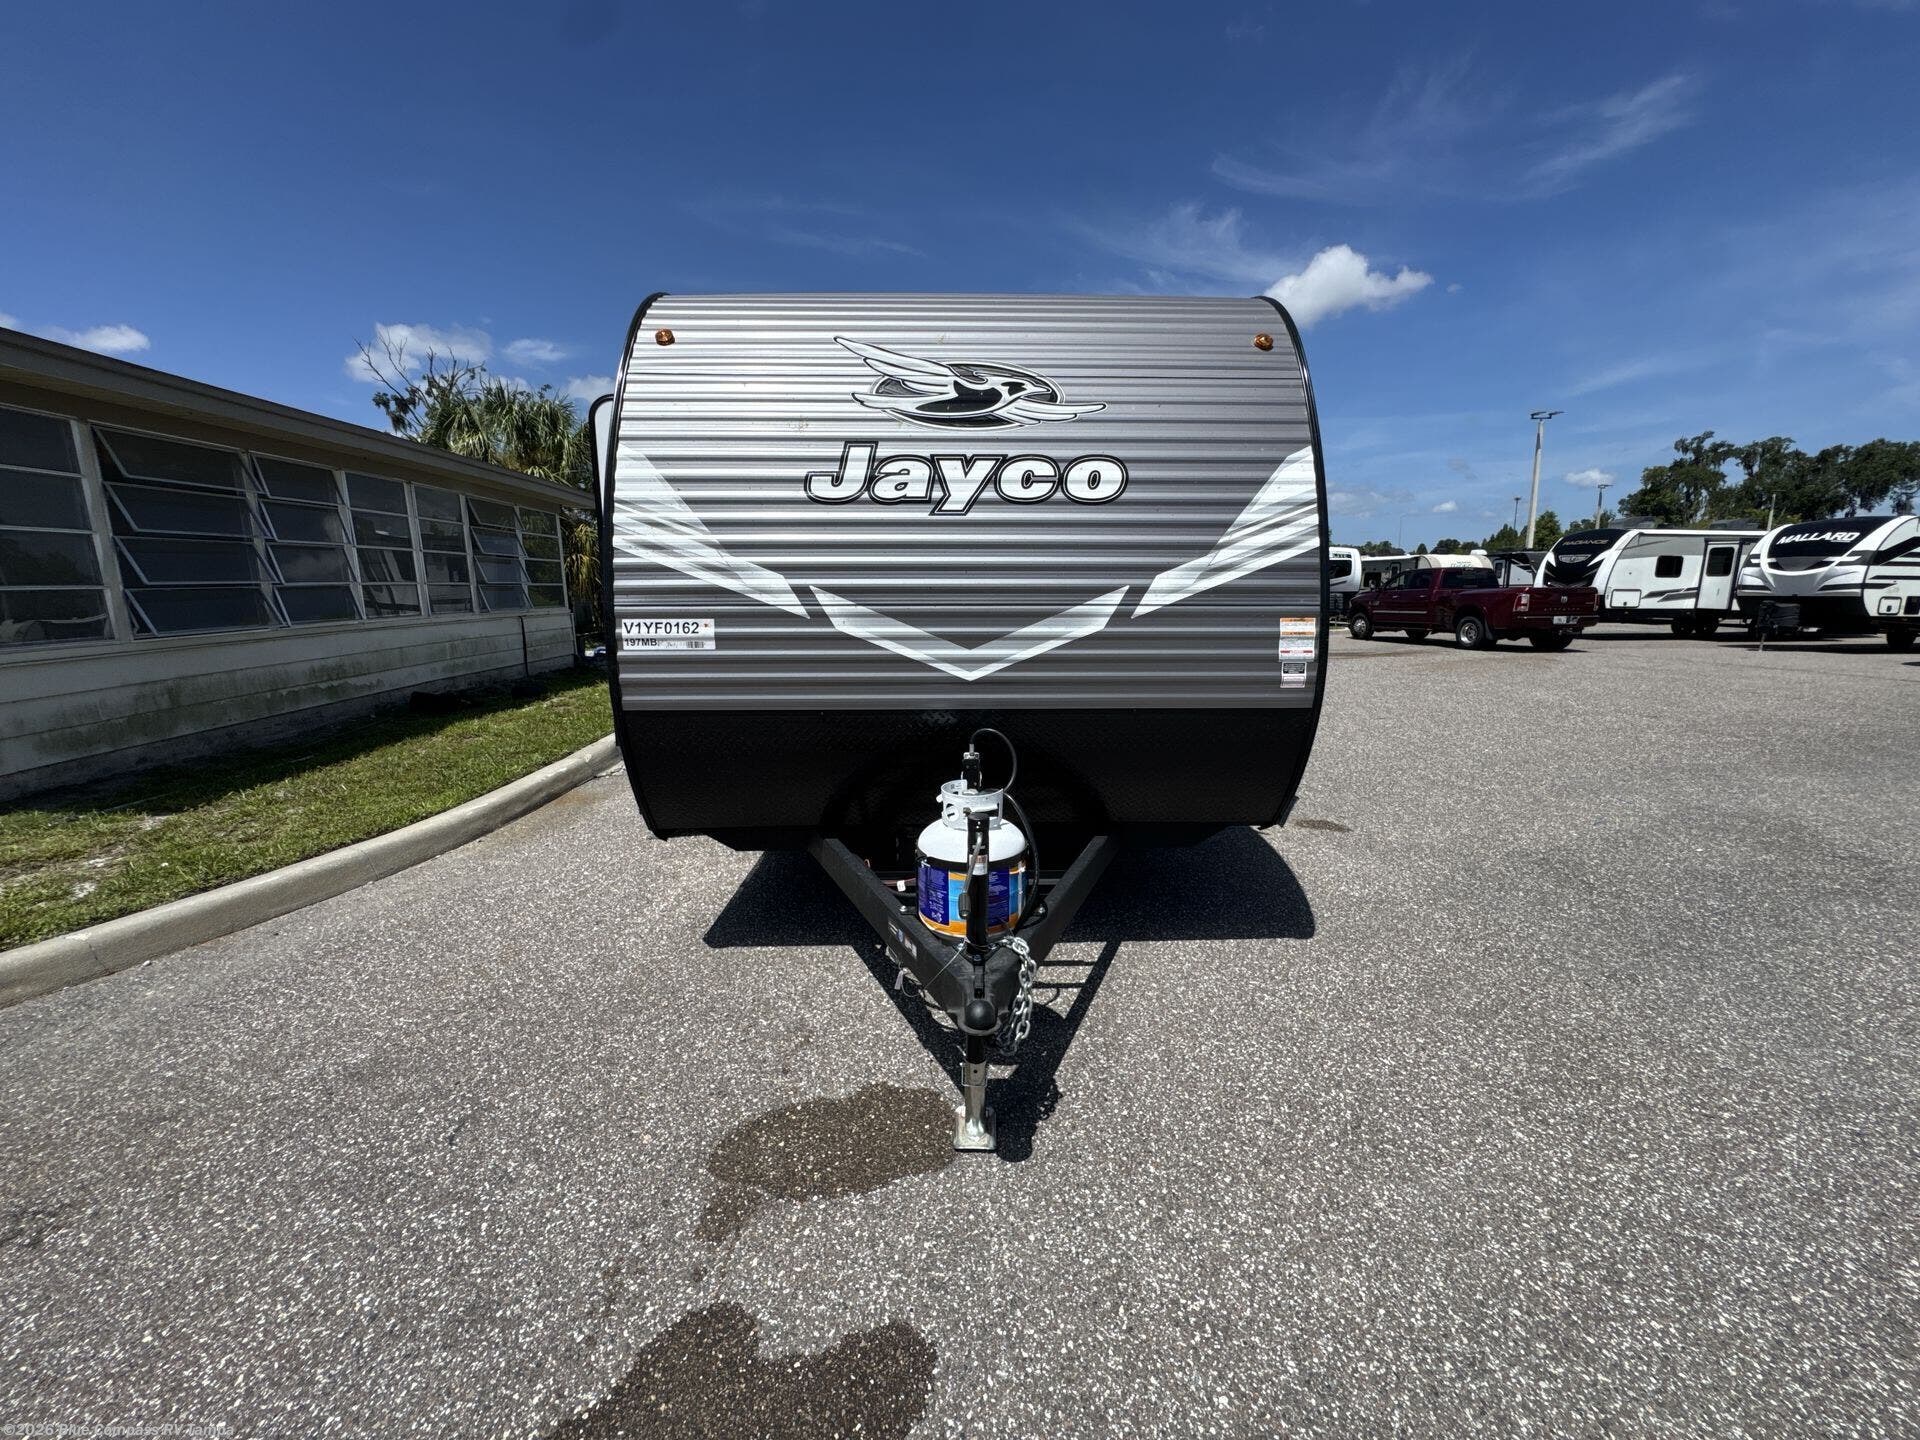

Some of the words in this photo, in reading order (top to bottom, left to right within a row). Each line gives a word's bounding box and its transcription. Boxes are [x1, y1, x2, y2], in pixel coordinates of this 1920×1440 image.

[804, 440, 1129, 516] Jayco
[1776, 532, 1861, 545] MALLARD
[623, 621, 700, 634] V1YF0162
